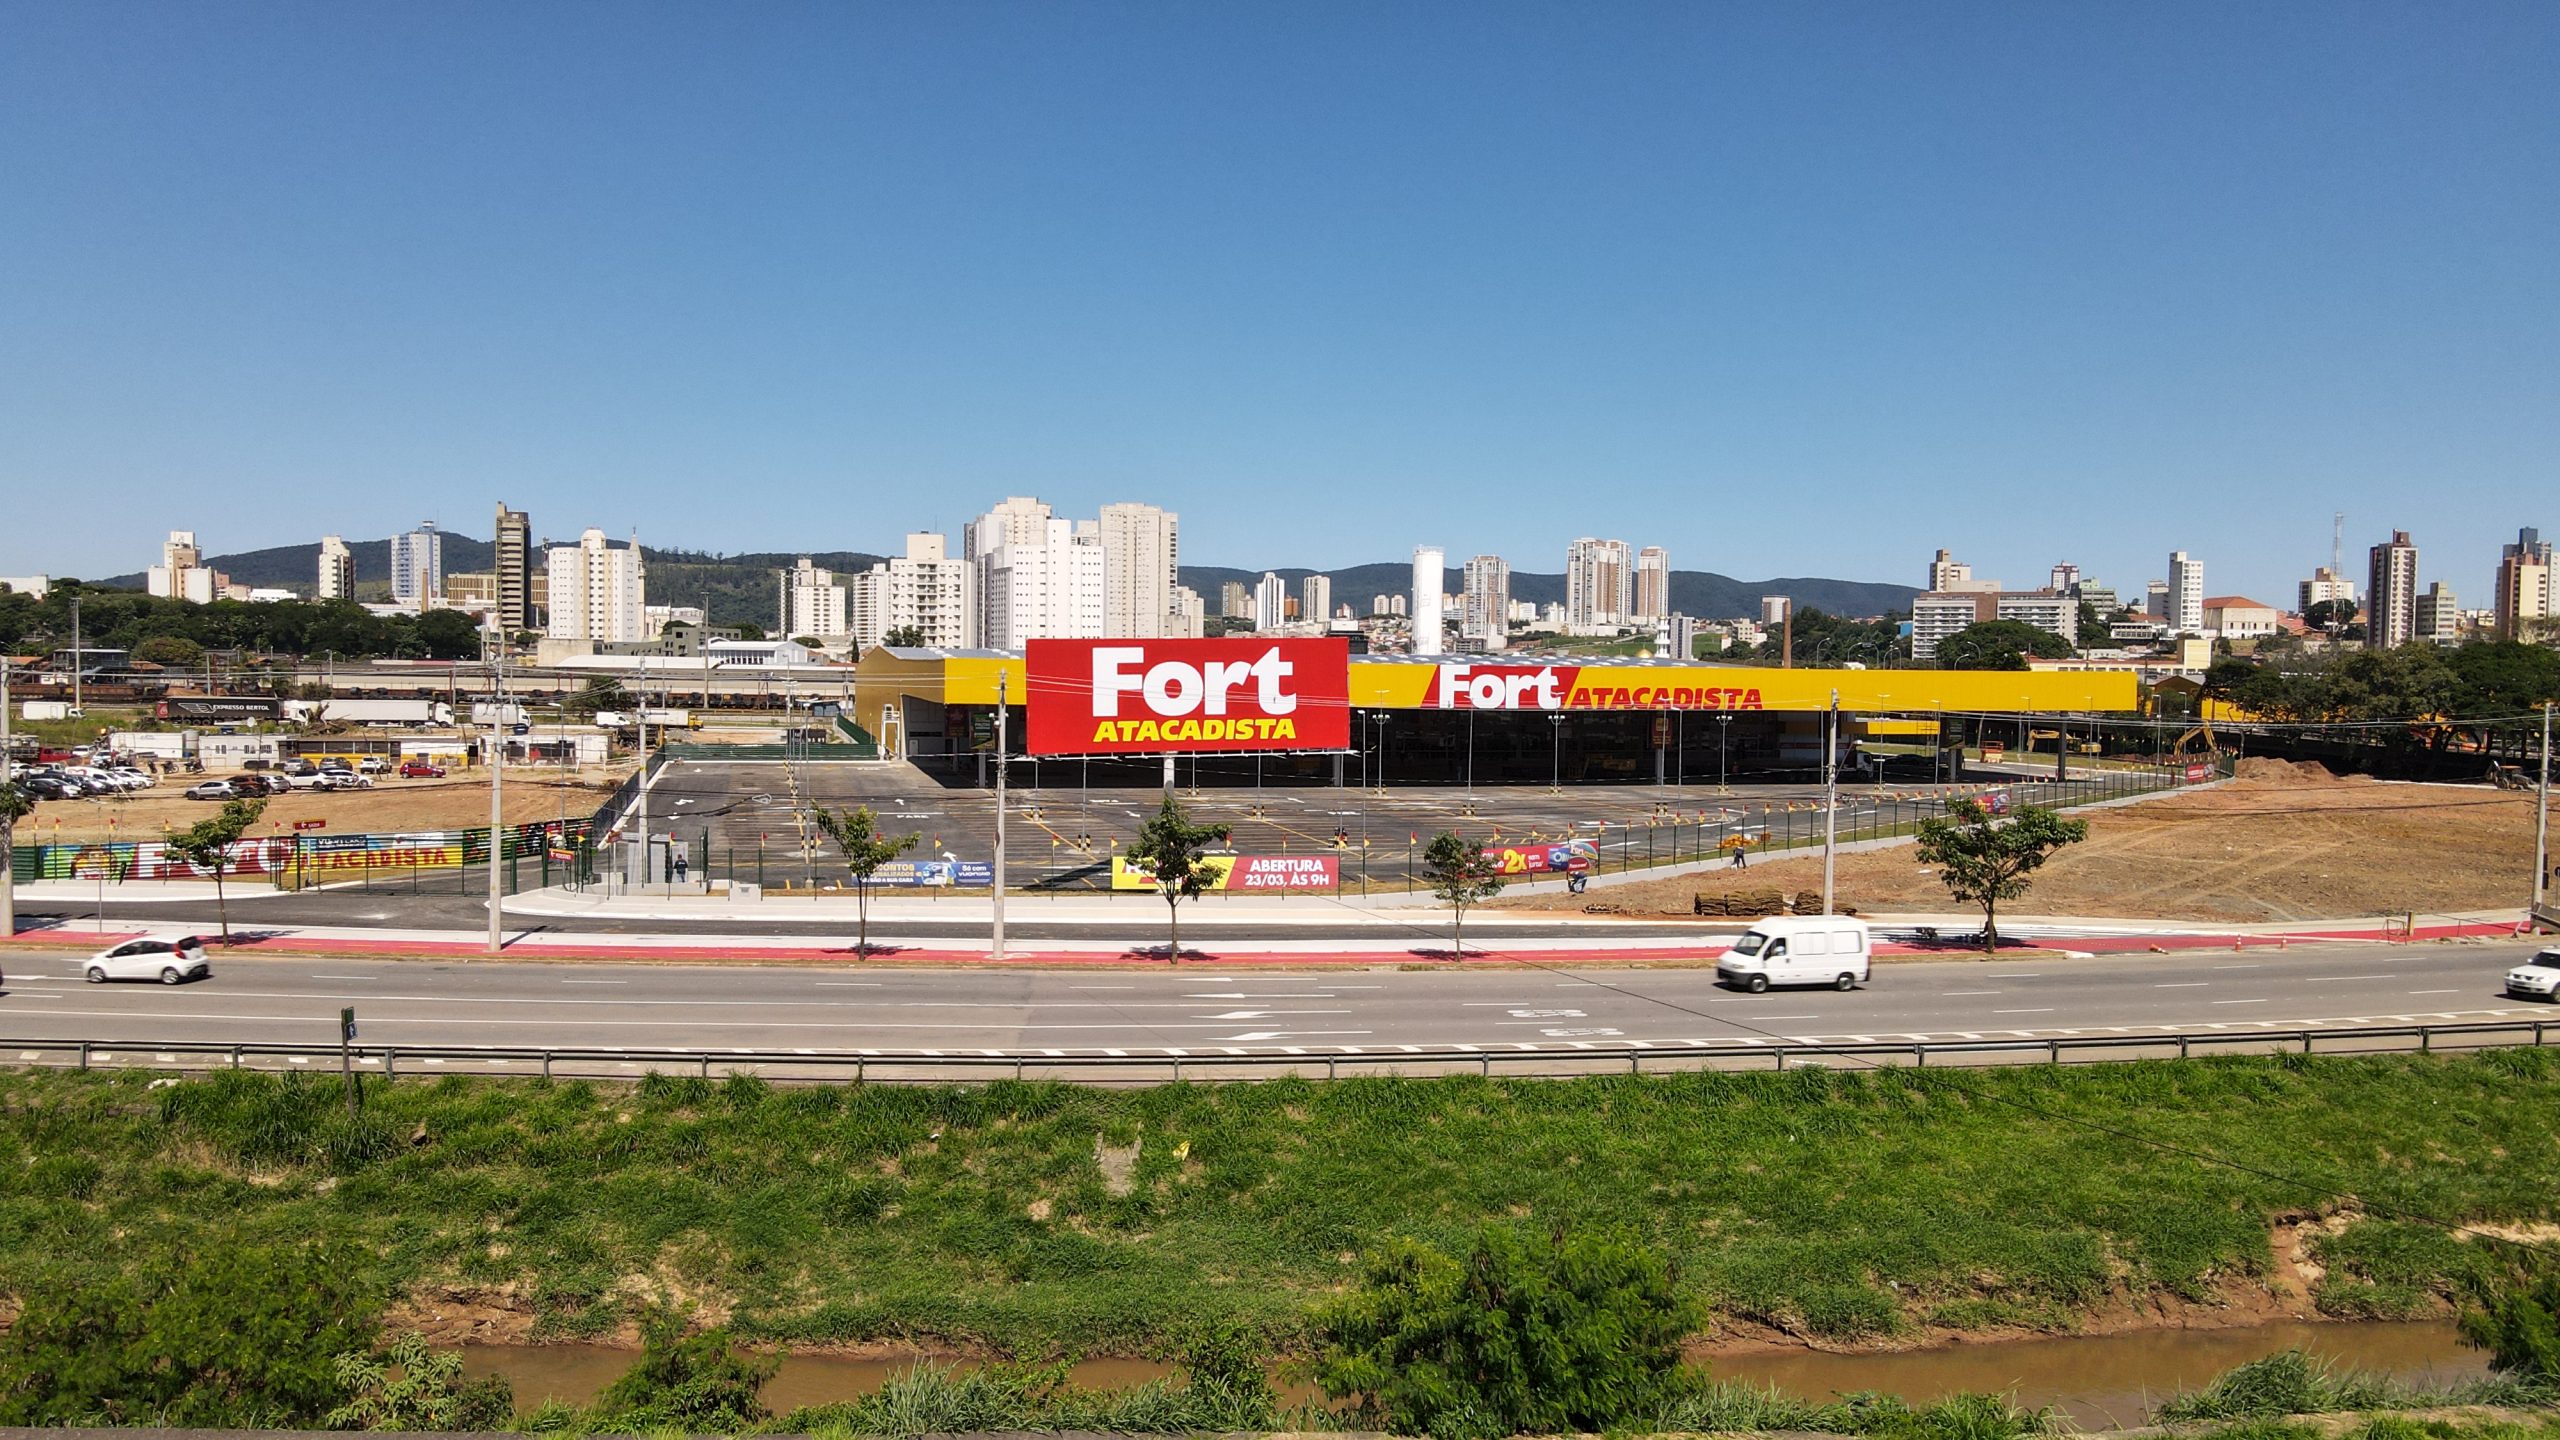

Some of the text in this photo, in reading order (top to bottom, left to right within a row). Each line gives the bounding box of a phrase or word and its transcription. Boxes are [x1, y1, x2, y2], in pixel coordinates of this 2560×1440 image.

[1092, 646, 1297, 718] Fort
[1439, 665, 1763, 709] Fort ATACADISTA
[1092, 719, 1297, 743] ATACADISTA
[1250, 859, 1324, 873] ABERTURA
[1245, 874, 1287, 887] 23/03,
[1311, 874, 1329, 886] 9H
